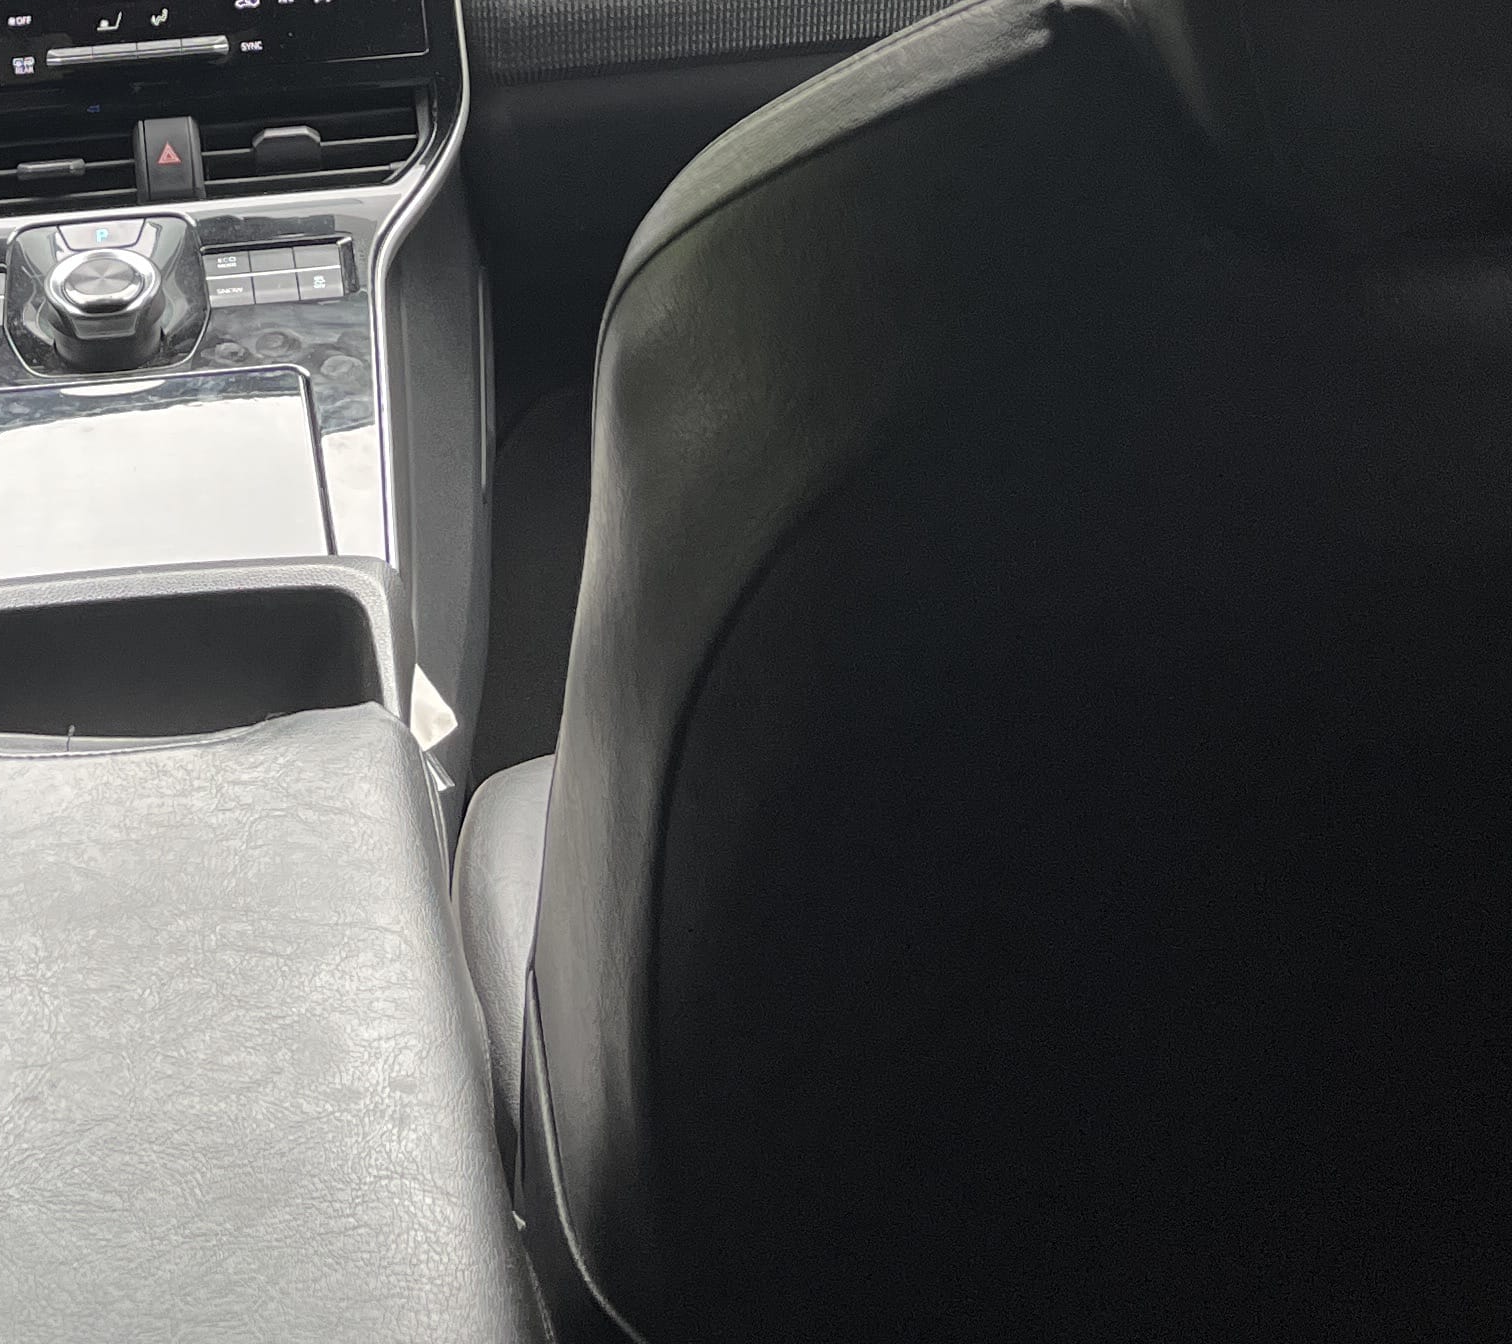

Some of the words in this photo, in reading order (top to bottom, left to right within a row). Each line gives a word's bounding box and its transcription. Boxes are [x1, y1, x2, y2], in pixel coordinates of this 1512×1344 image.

[16, 15, 32, 26] OFF
[240, 40, 264, 52] SYNC
[95, 228, 109, 243] P
[217, 255, 237, 264] ECO
